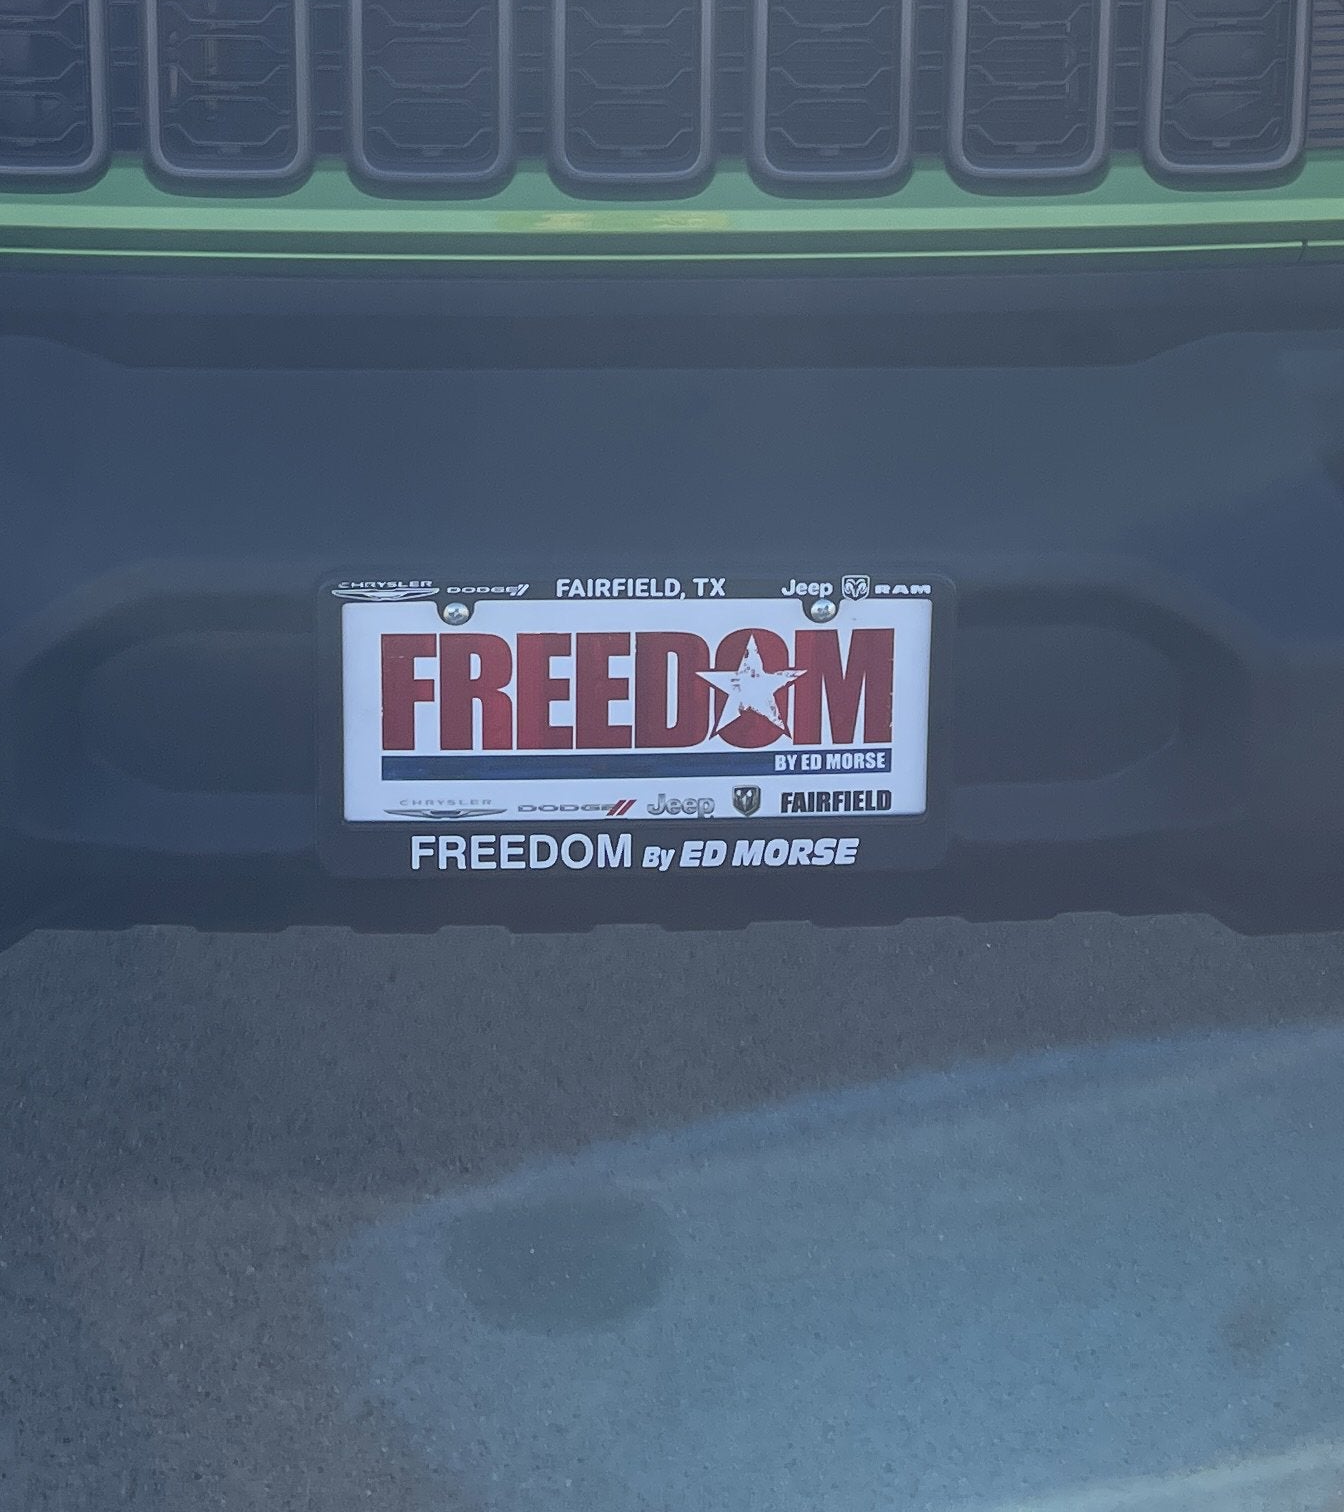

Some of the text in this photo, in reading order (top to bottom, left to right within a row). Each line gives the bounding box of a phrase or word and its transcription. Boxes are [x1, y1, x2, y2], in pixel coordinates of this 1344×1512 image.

[338, 580, 433, 588] CHRYSLER
[555, 577, 727, 600] FAIRFIELD, TX
[781, 578, 932, 599] Jeep RAM
[380, 628, 896, 751] FREEDOM
[774, 751, 886, 772] BY ED MORSE
[399, 798, 493, 807] CHRYSLER
[647, 793, 716, 819] Jeep
[780, 789, 893, 814] FAIRFIELD
[410, 832, 860, 871] FREEDOM By ED MORSE
